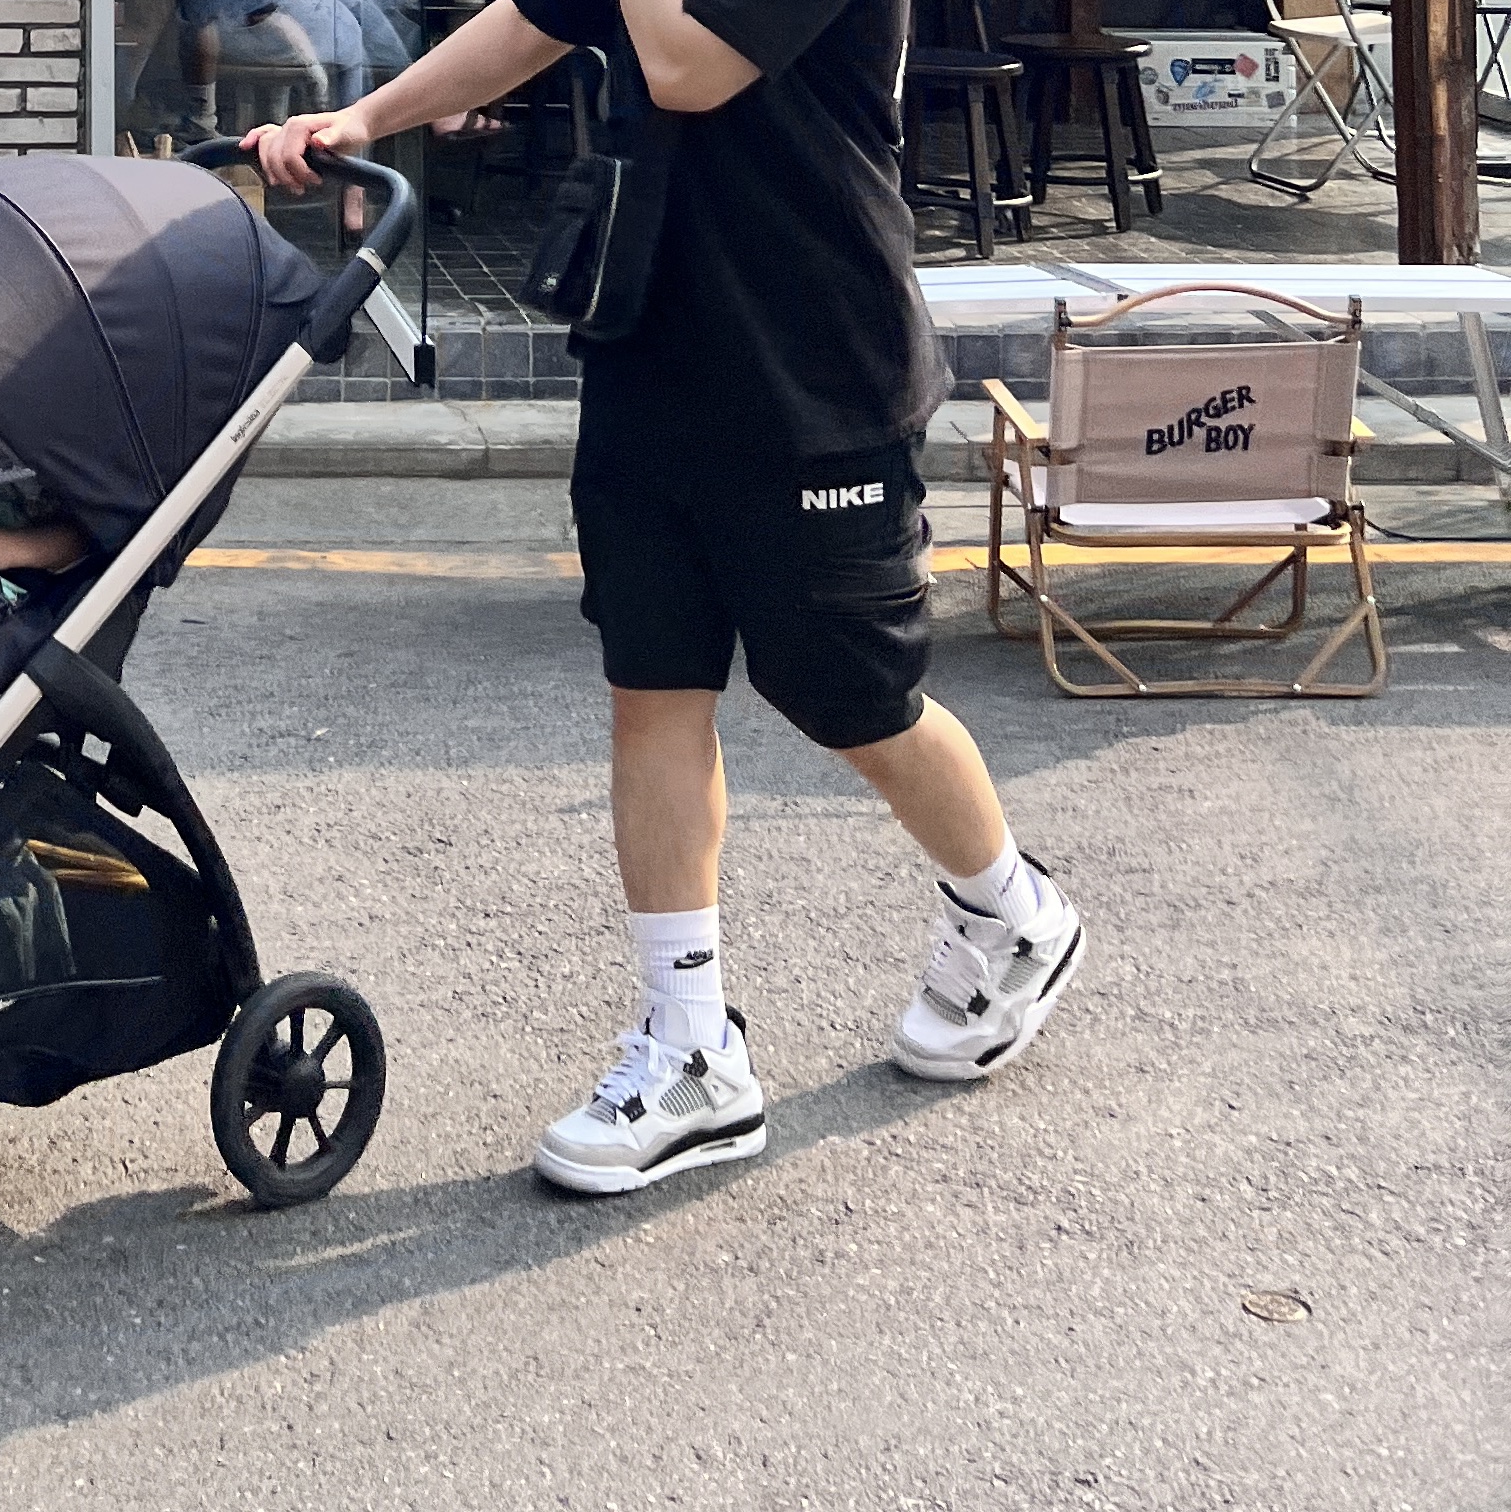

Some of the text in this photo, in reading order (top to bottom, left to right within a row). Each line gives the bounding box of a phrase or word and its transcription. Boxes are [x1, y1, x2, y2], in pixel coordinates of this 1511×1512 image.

[1145, 385, 1257, 456] BURGER
[1205, 423, 1256, 453] BOY
[800, 482, 885, 510] NIKE
